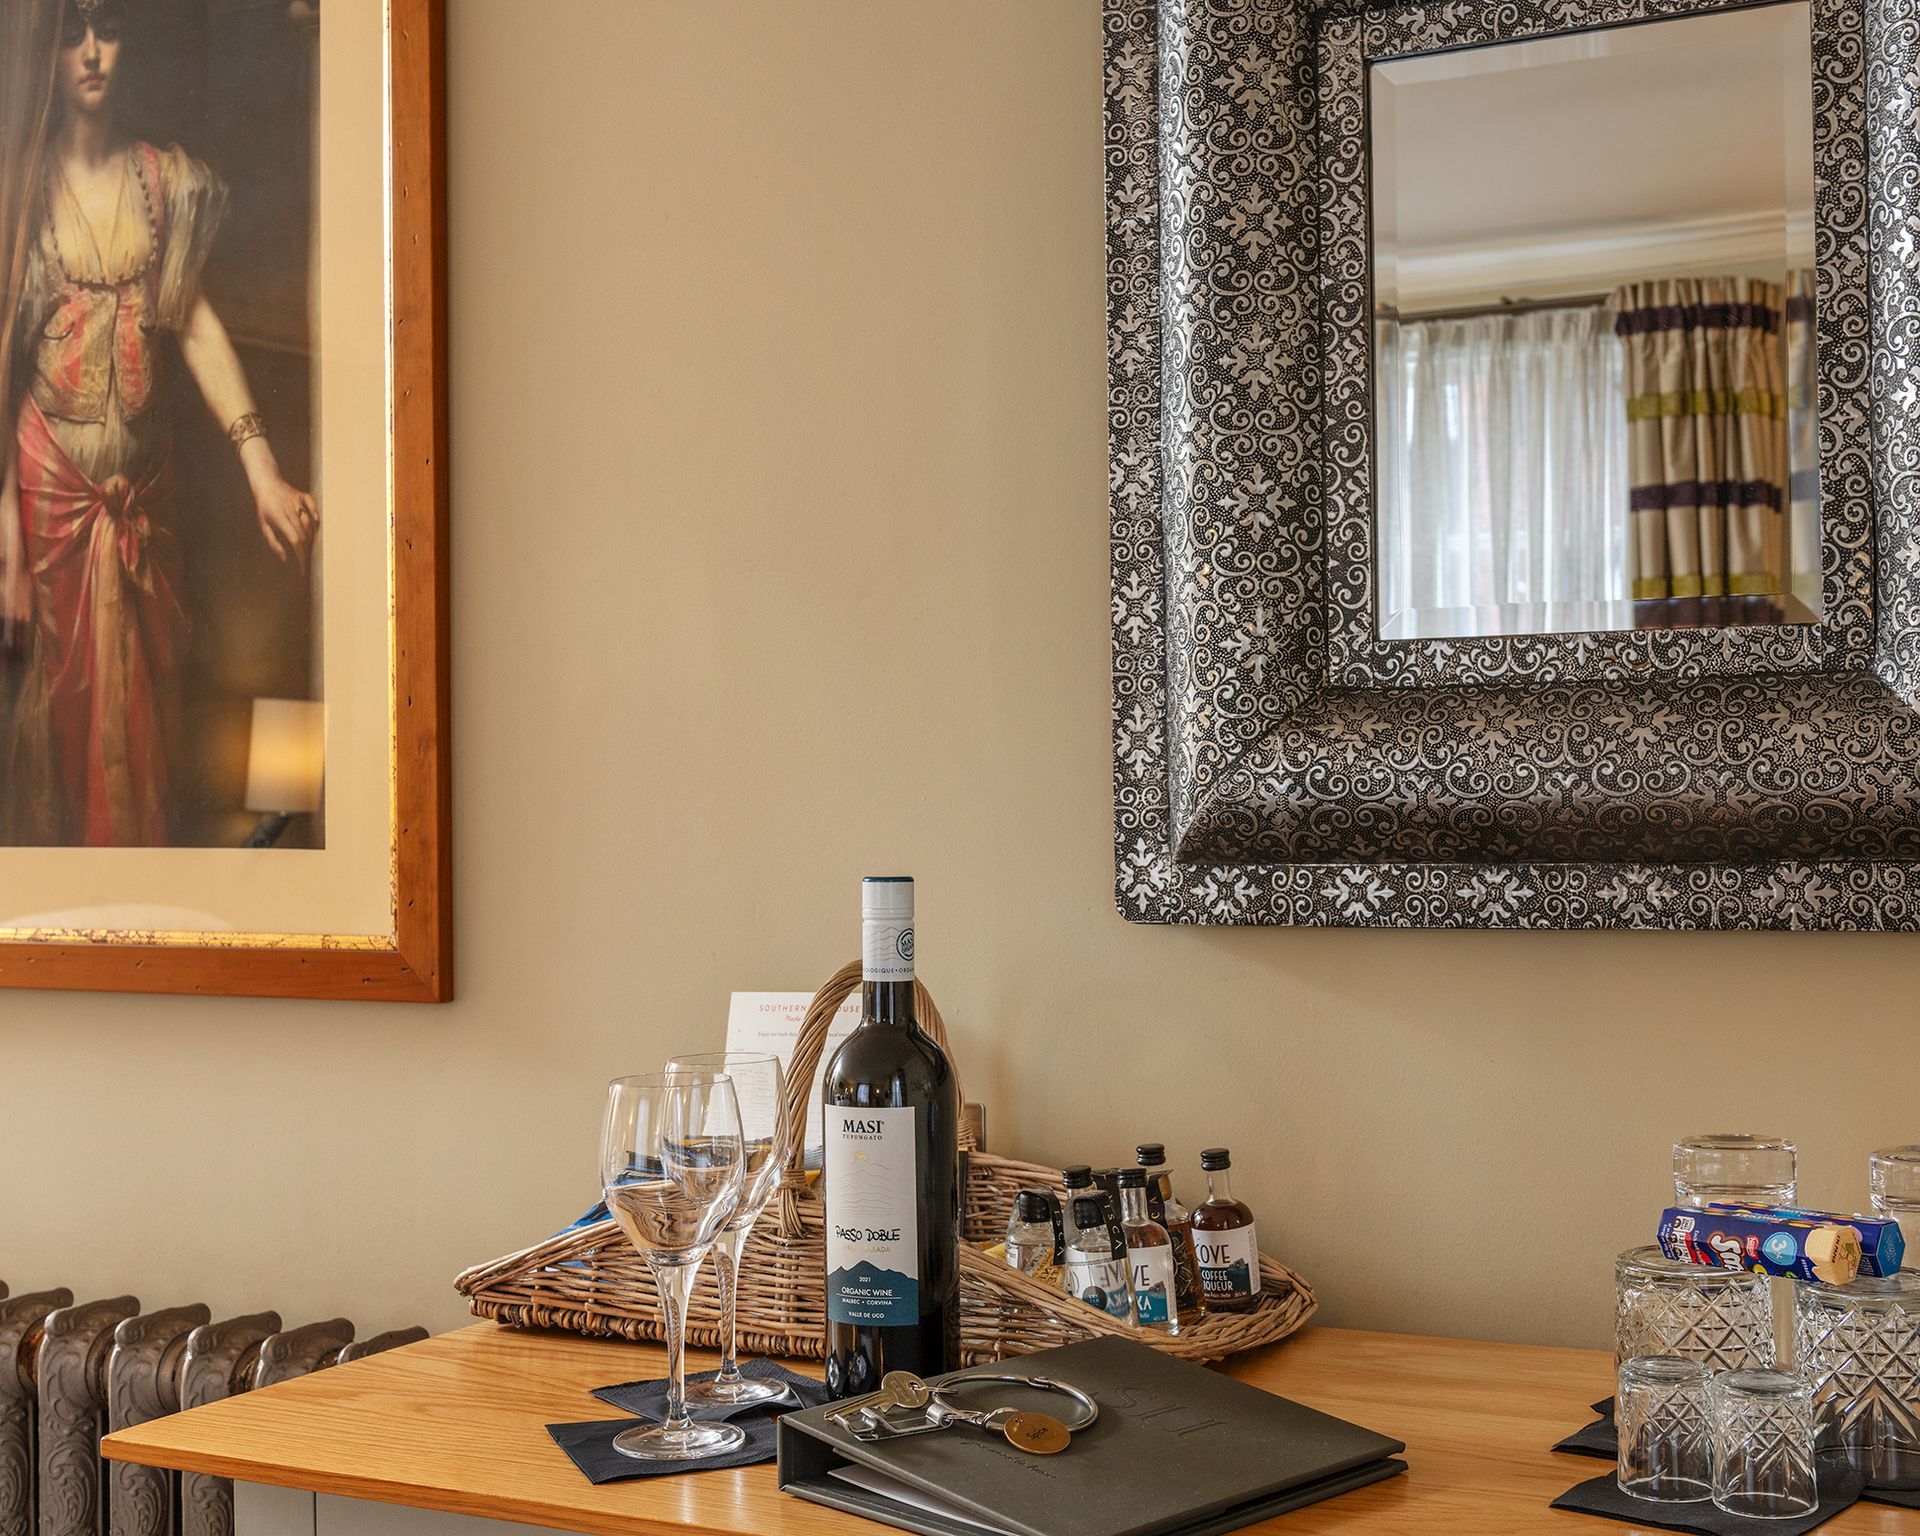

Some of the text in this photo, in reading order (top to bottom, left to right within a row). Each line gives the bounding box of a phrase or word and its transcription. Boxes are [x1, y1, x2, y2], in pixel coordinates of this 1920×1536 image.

[838, 1004, 861, 1013] OUSE
[835, 1225, 901, 1242] PASSO DOBLE
[1201, 1270, 1228, 1281] COFFEE
[1203, 1280, 1234, 1292] IQUEUR
[841, 1287, 893, 1297] ORGANIC WINE
